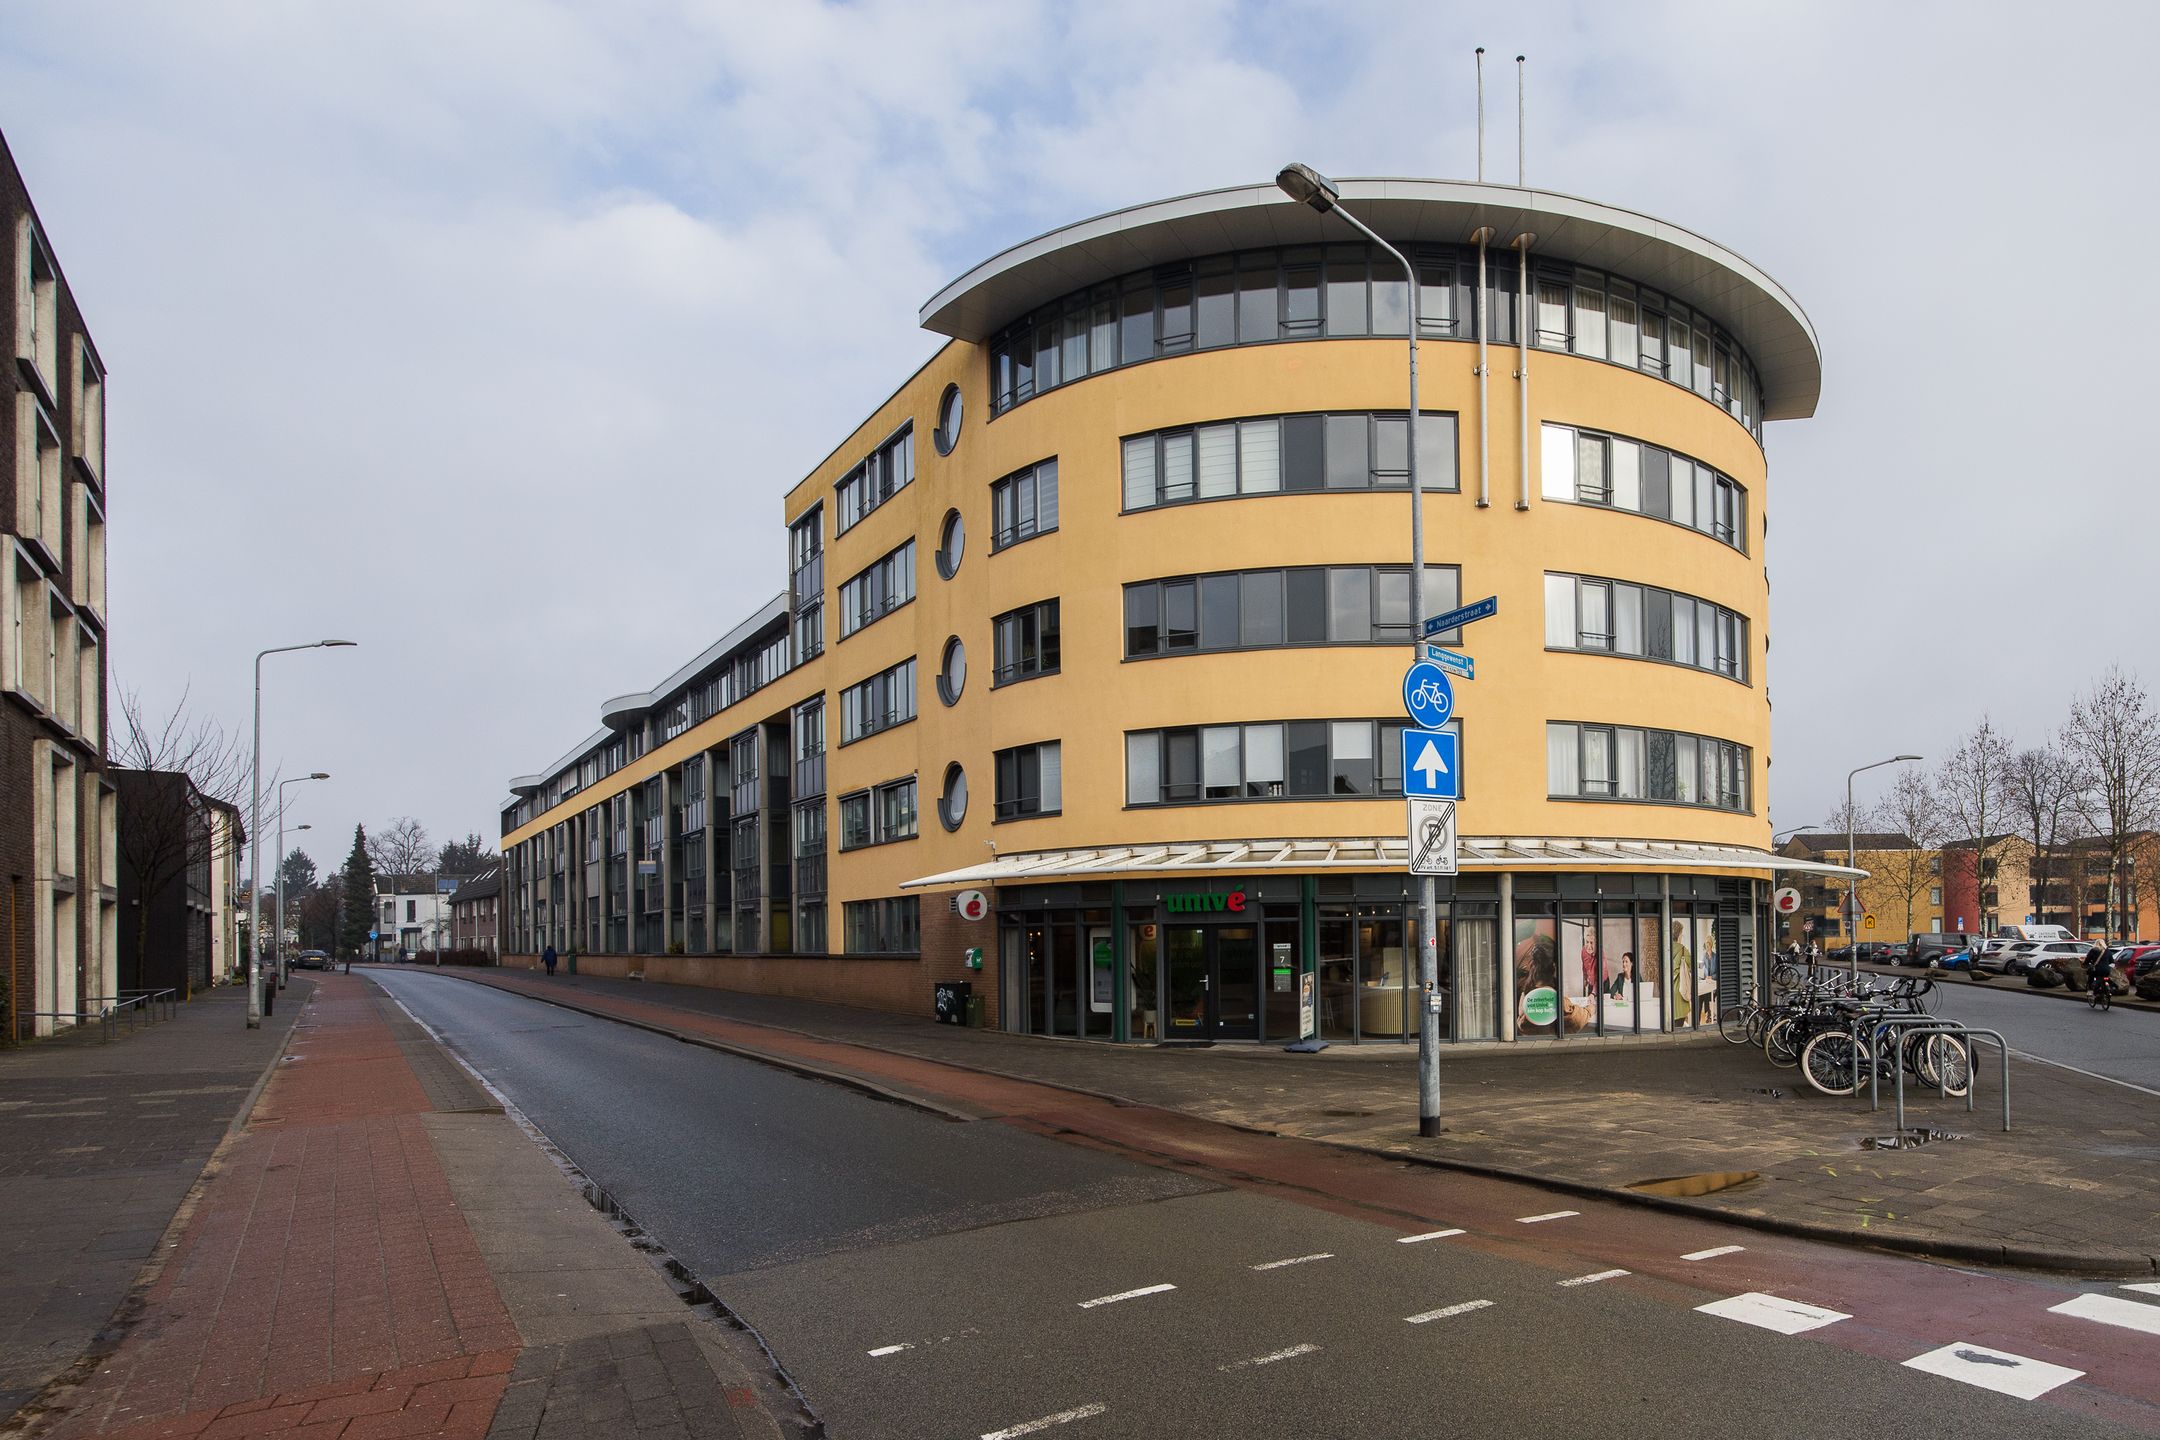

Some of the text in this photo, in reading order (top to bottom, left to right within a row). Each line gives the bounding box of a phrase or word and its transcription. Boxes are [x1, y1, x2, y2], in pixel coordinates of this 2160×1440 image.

[1436, 606, 1482, 628] Naarderstraat
[1422, 804, 1443, 813] ZONE
[1167, 883, 1246, 912] univé
